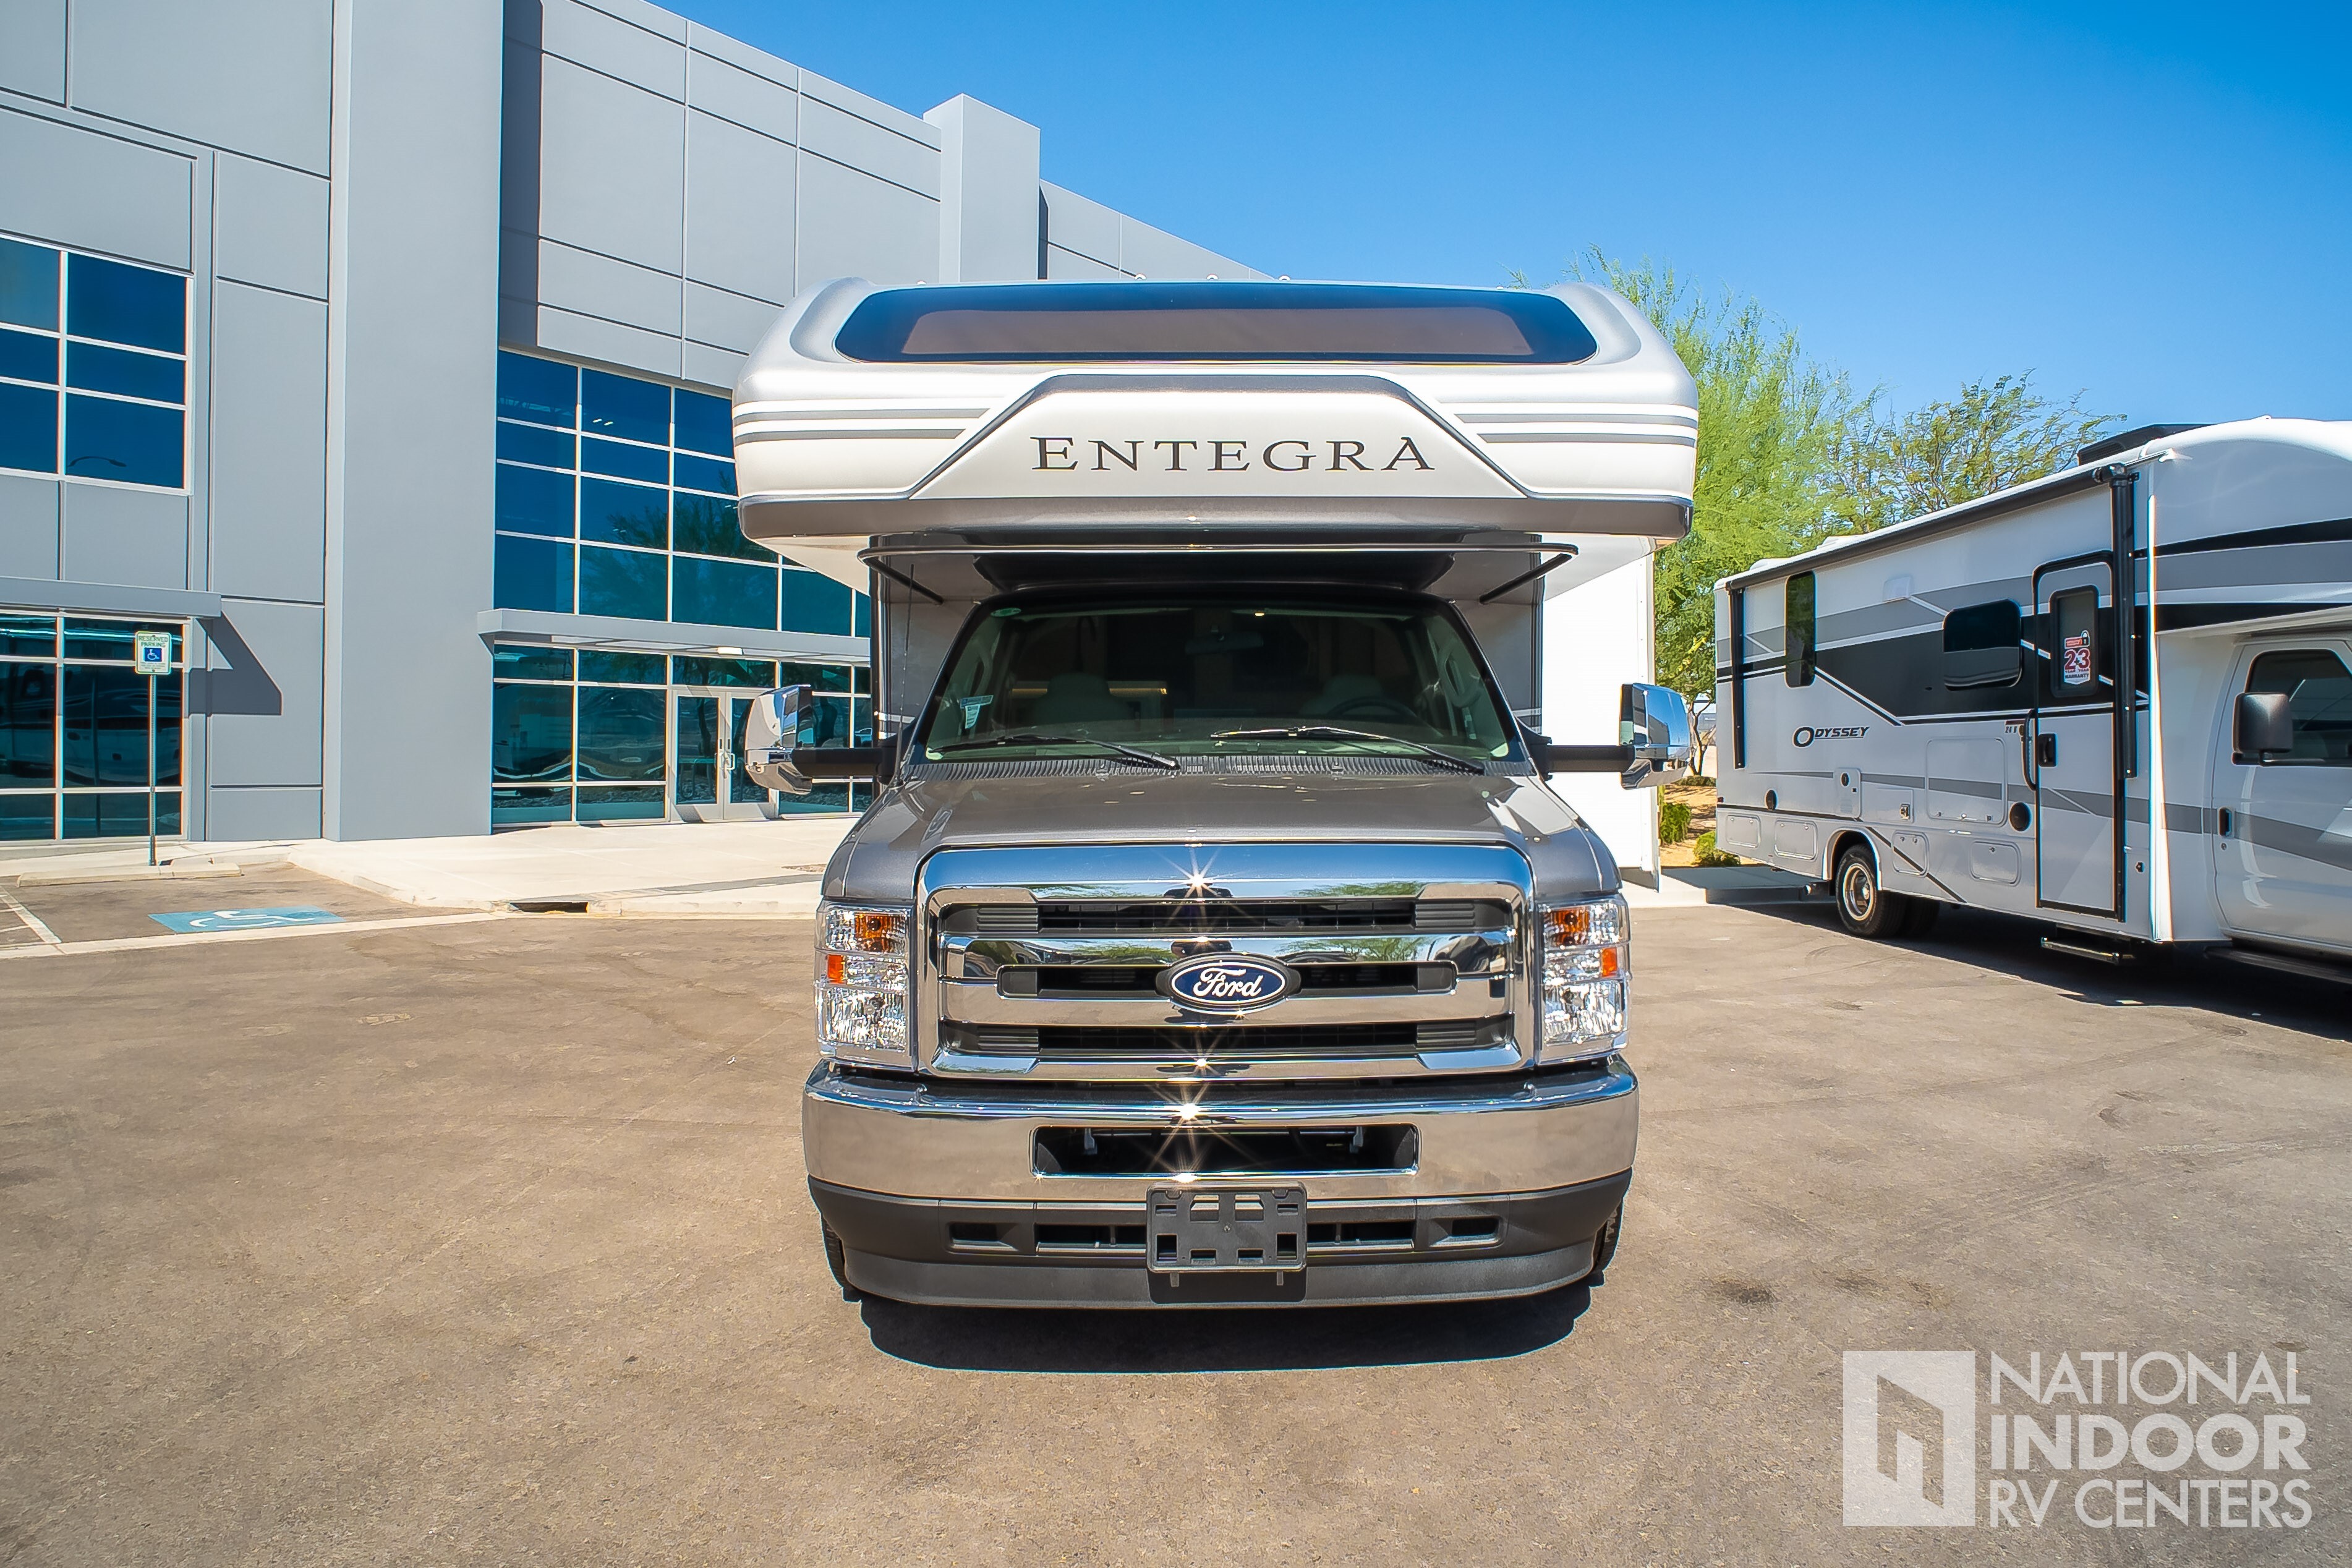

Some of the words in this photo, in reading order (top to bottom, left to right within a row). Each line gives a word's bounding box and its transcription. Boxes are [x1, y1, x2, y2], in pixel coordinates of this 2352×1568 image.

[1029, 436, 1436, 472] ENTEGRA
[1793, 726, 1870, 748] ODYSSEY
[1193, 967, 1264, 997] Ford
